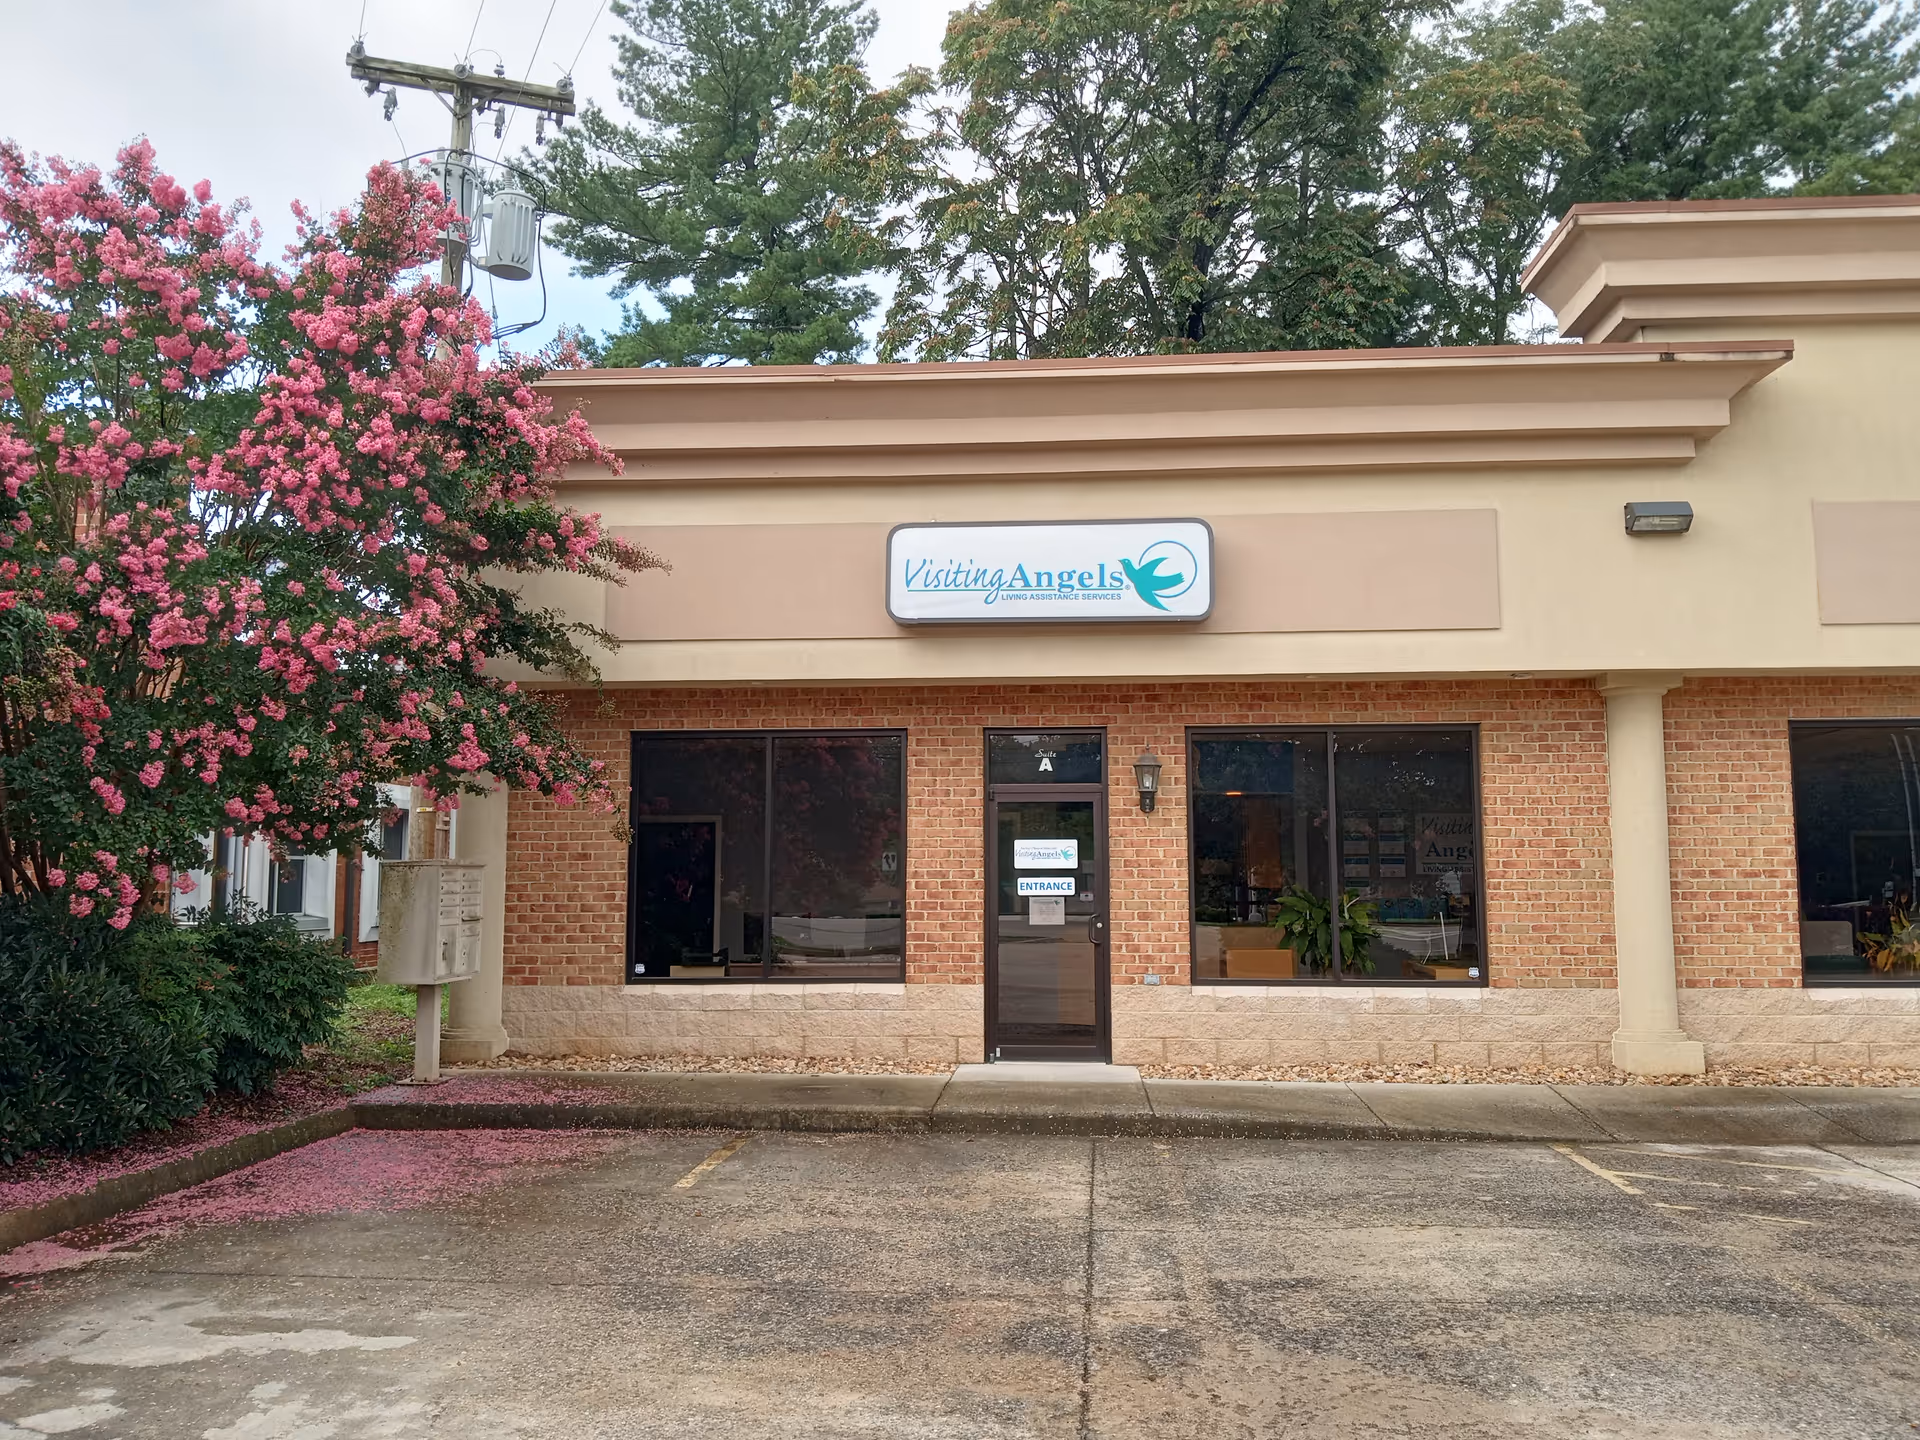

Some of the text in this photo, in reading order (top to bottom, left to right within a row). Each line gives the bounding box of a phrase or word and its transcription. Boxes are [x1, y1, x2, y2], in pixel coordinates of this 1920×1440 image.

[905, 558, 1124, 605] Visiting Angels
[1001, 593, 1028, 601] LIVING
[1029, 593, 1080, 601] ASSISTANCE
[1034, 749, 1057, 757] Suite
[1038, 758, 1053, 771] A
[1421, 816, 1473, 835] Visitin
[1037, 850, 1062, 859] Angels
[1020, 882, 1073, 891] ENTRANCE
